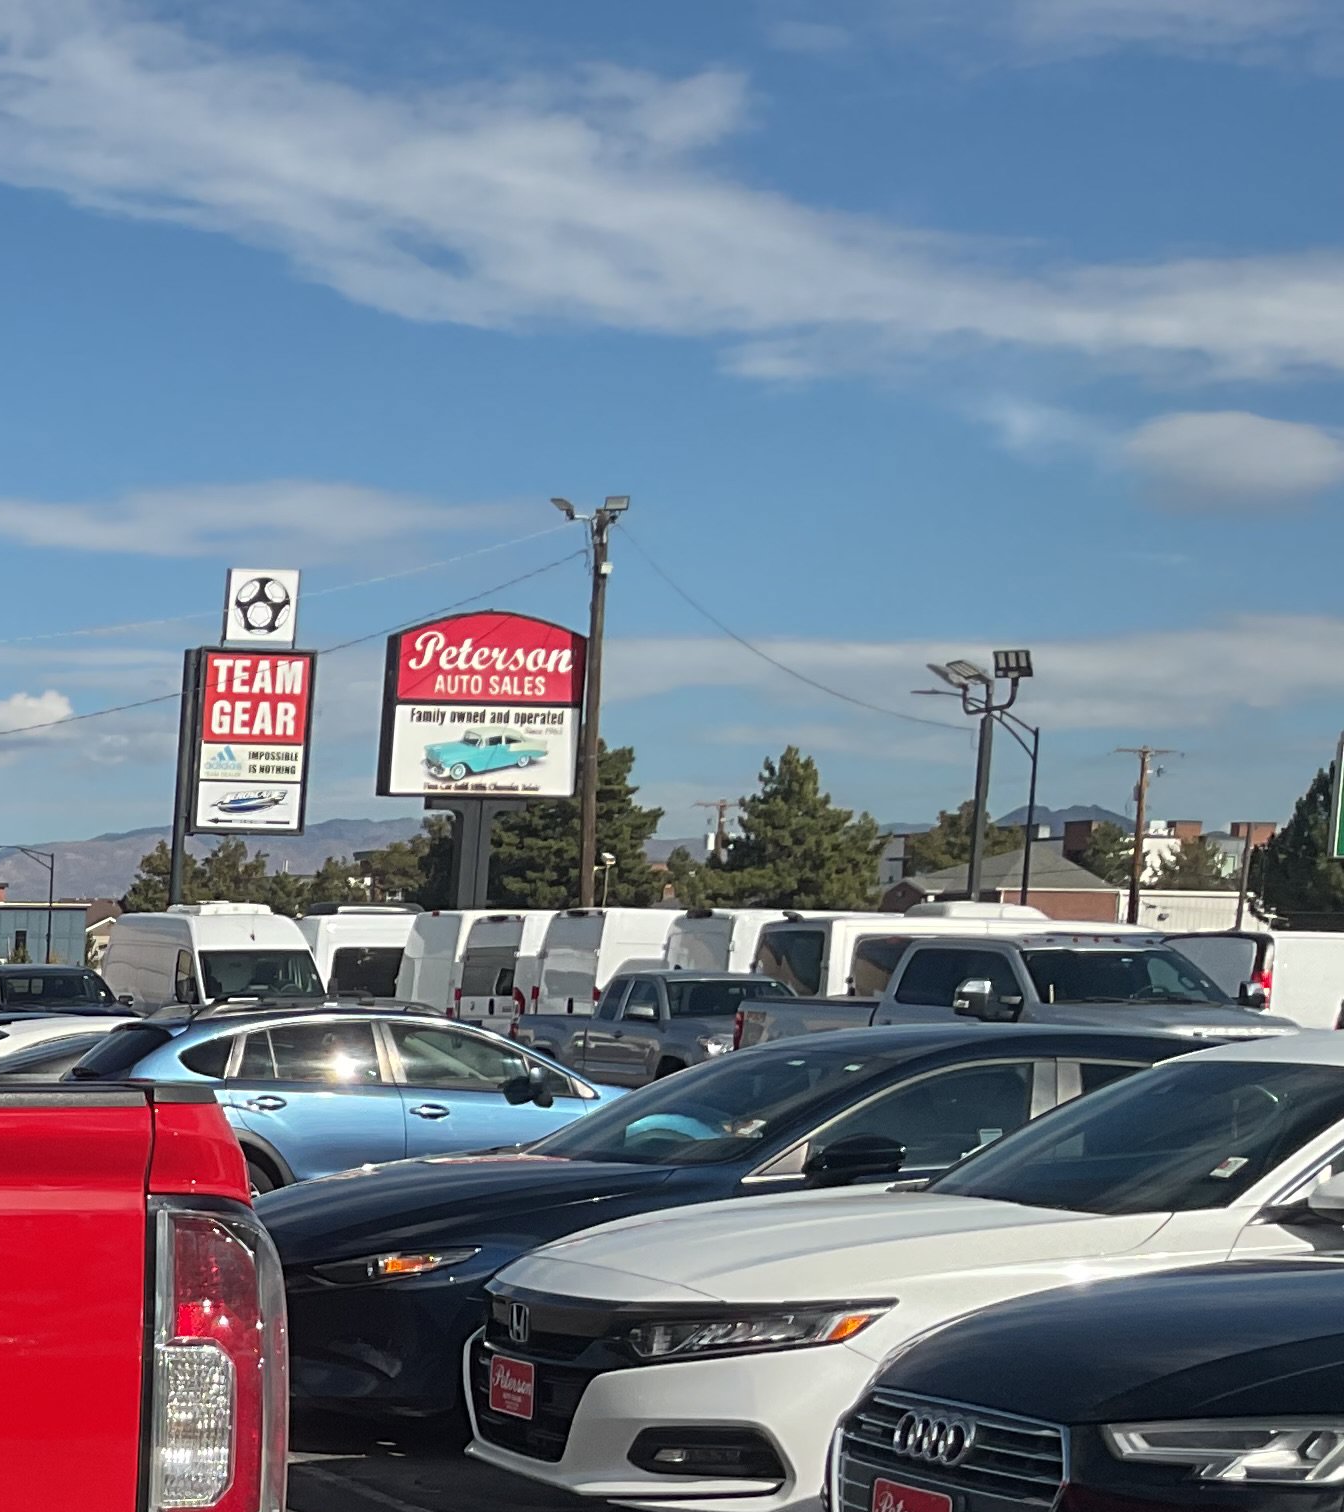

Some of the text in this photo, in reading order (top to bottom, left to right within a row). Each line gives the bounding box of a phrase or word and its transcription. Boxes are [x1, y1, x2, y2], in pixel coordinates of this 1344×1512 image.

[408, 630, 574, 673] Peterson
[213, 658, 304, 695] TEAM
[434, 674, 546, 696] AUTO SALES
[210, 700, 297, 736] GEAR
[410, 707, 565, 727] Family owned and operated
[248, 750, 299, 762] IMPOSSIBLE
[248, 764, 296, 775] IS NOTHING
